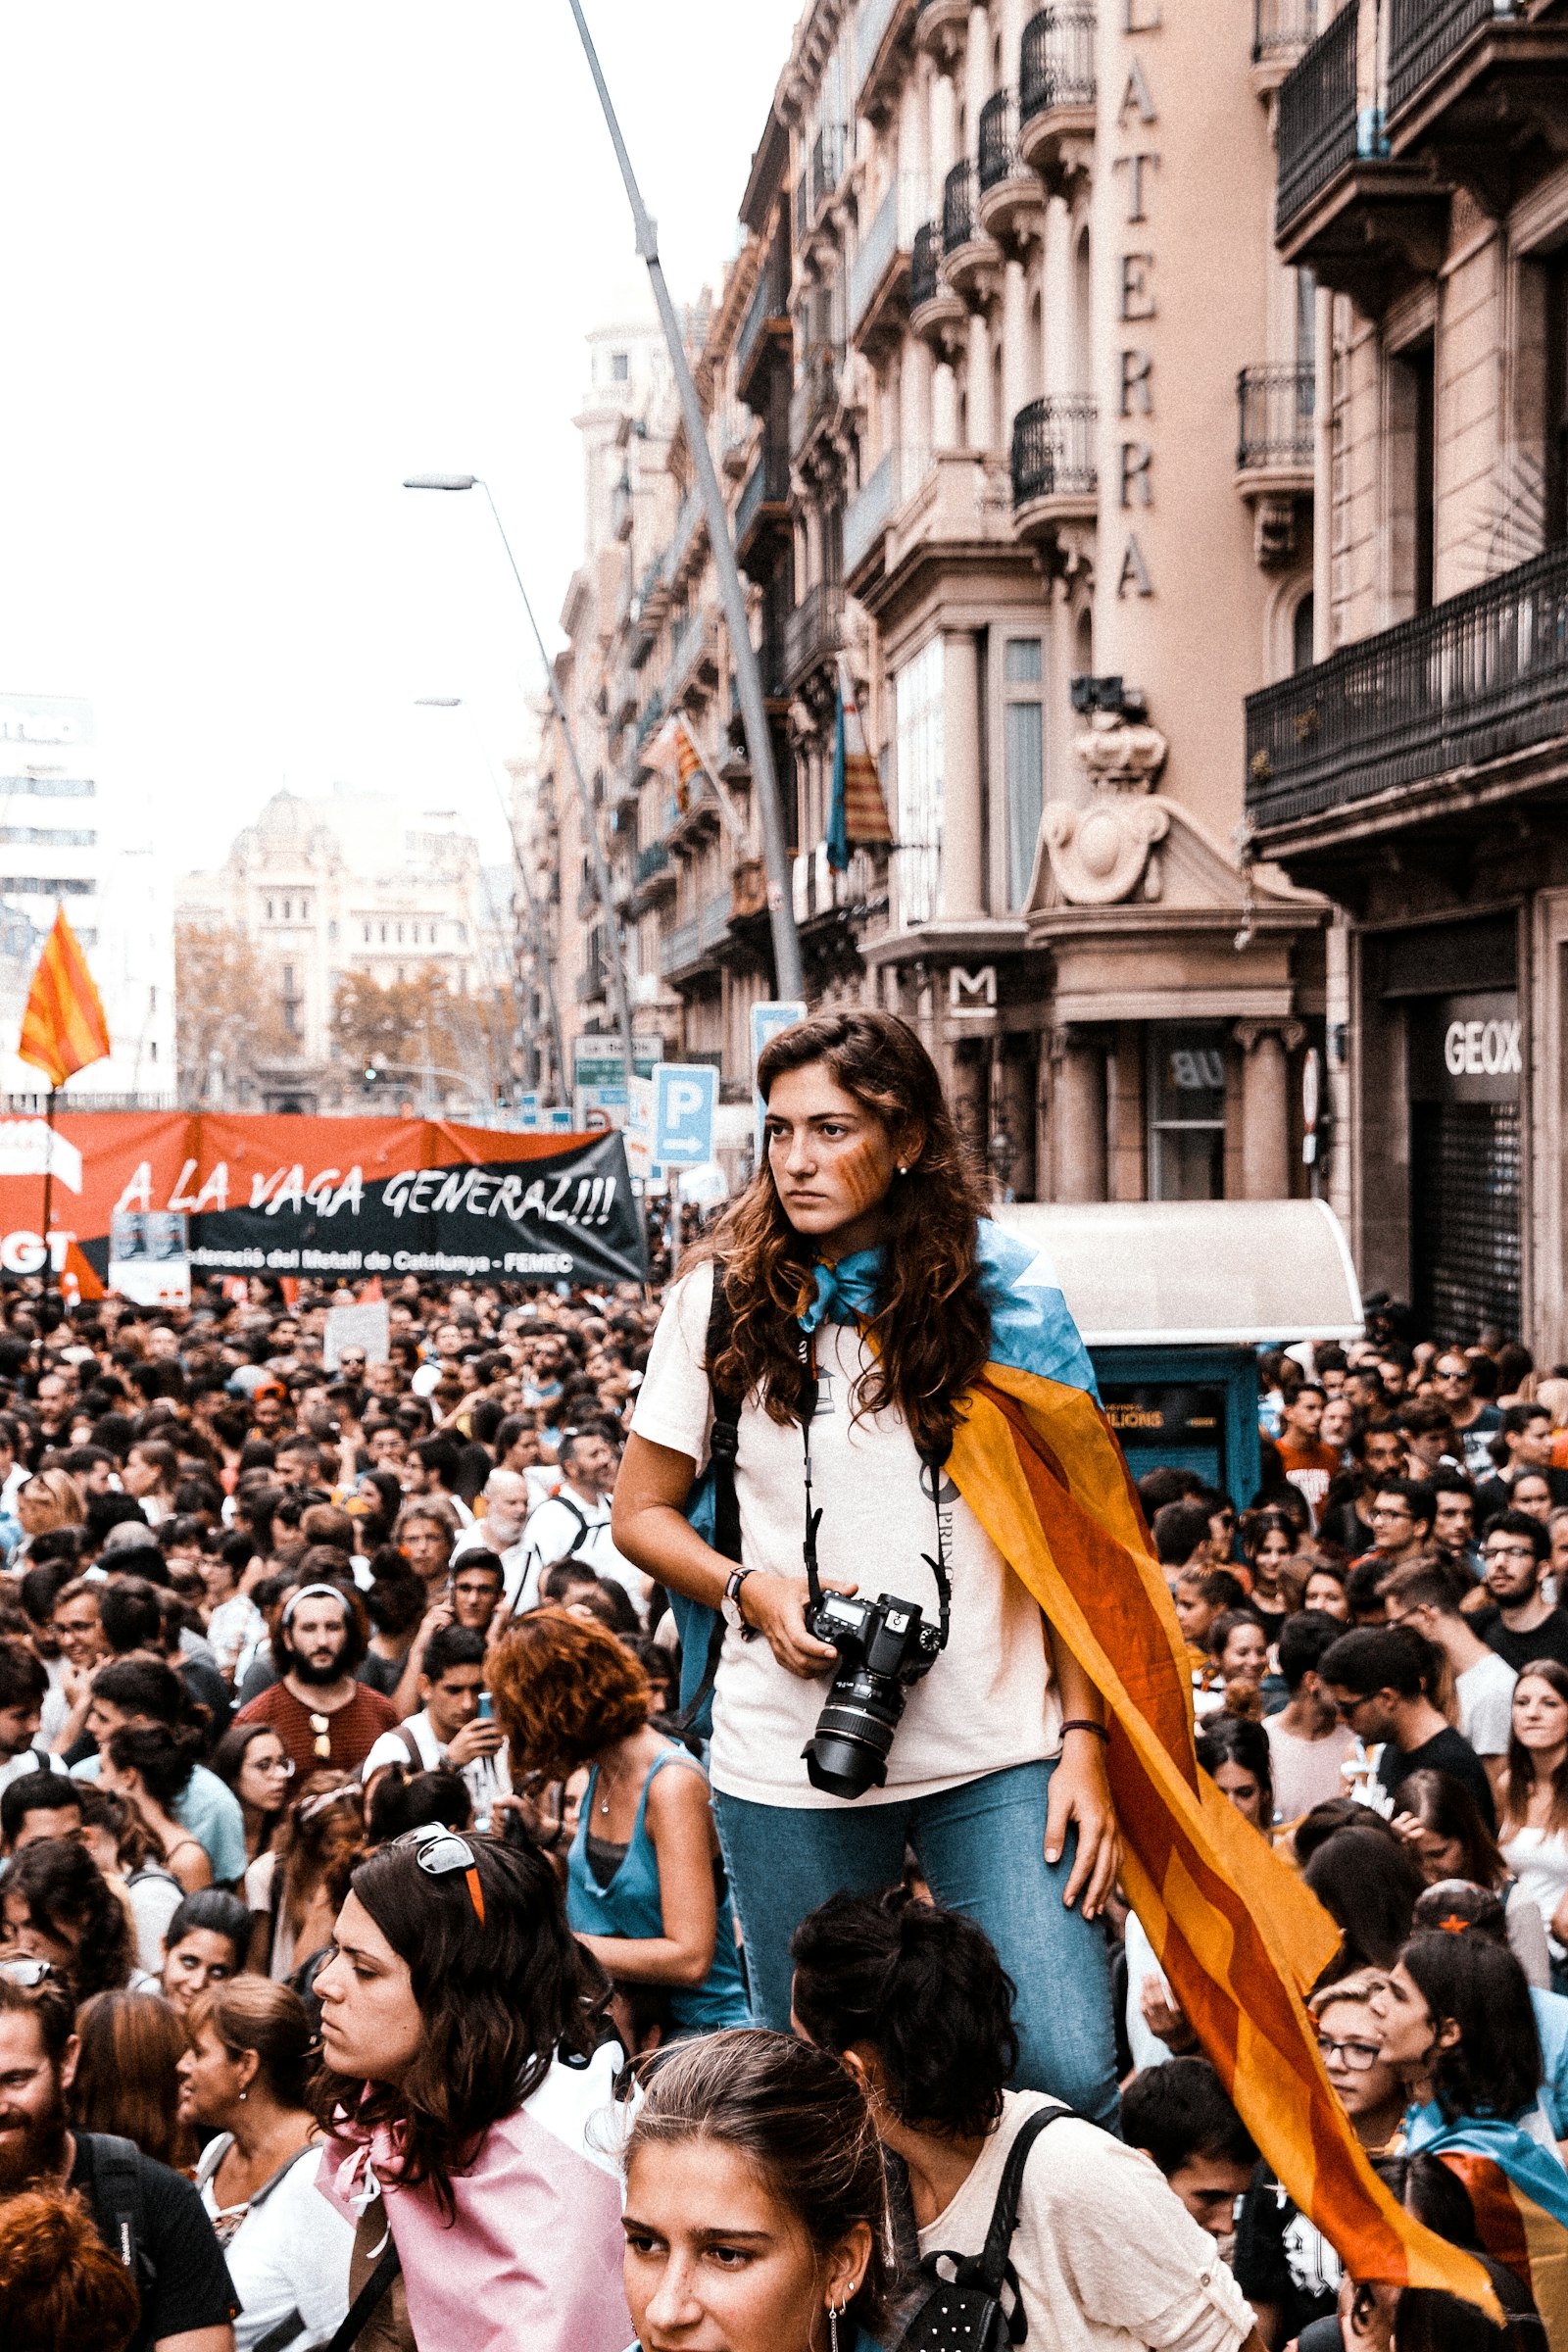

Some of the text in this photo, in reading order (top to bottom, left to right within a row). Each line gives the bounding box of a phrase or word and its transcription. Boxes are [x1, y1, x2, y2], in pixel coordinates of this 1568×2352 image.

[1445, 1020, 1522, 1075] GEOX
[666, 1080, 704, 1130] P
[113, 1157, 617, 1226] A LA VAGA GENERAL!!!
[0, 1231, 77, 1273] GT
[267, 1248, 301, 1269] del
[301, 1248, 363, 1271] Metall
[364, 1250, 392, 1272] de
[393, 1250, 491, 1277] Catalunya
[504, 1252, 574, 1274] FEMEC
